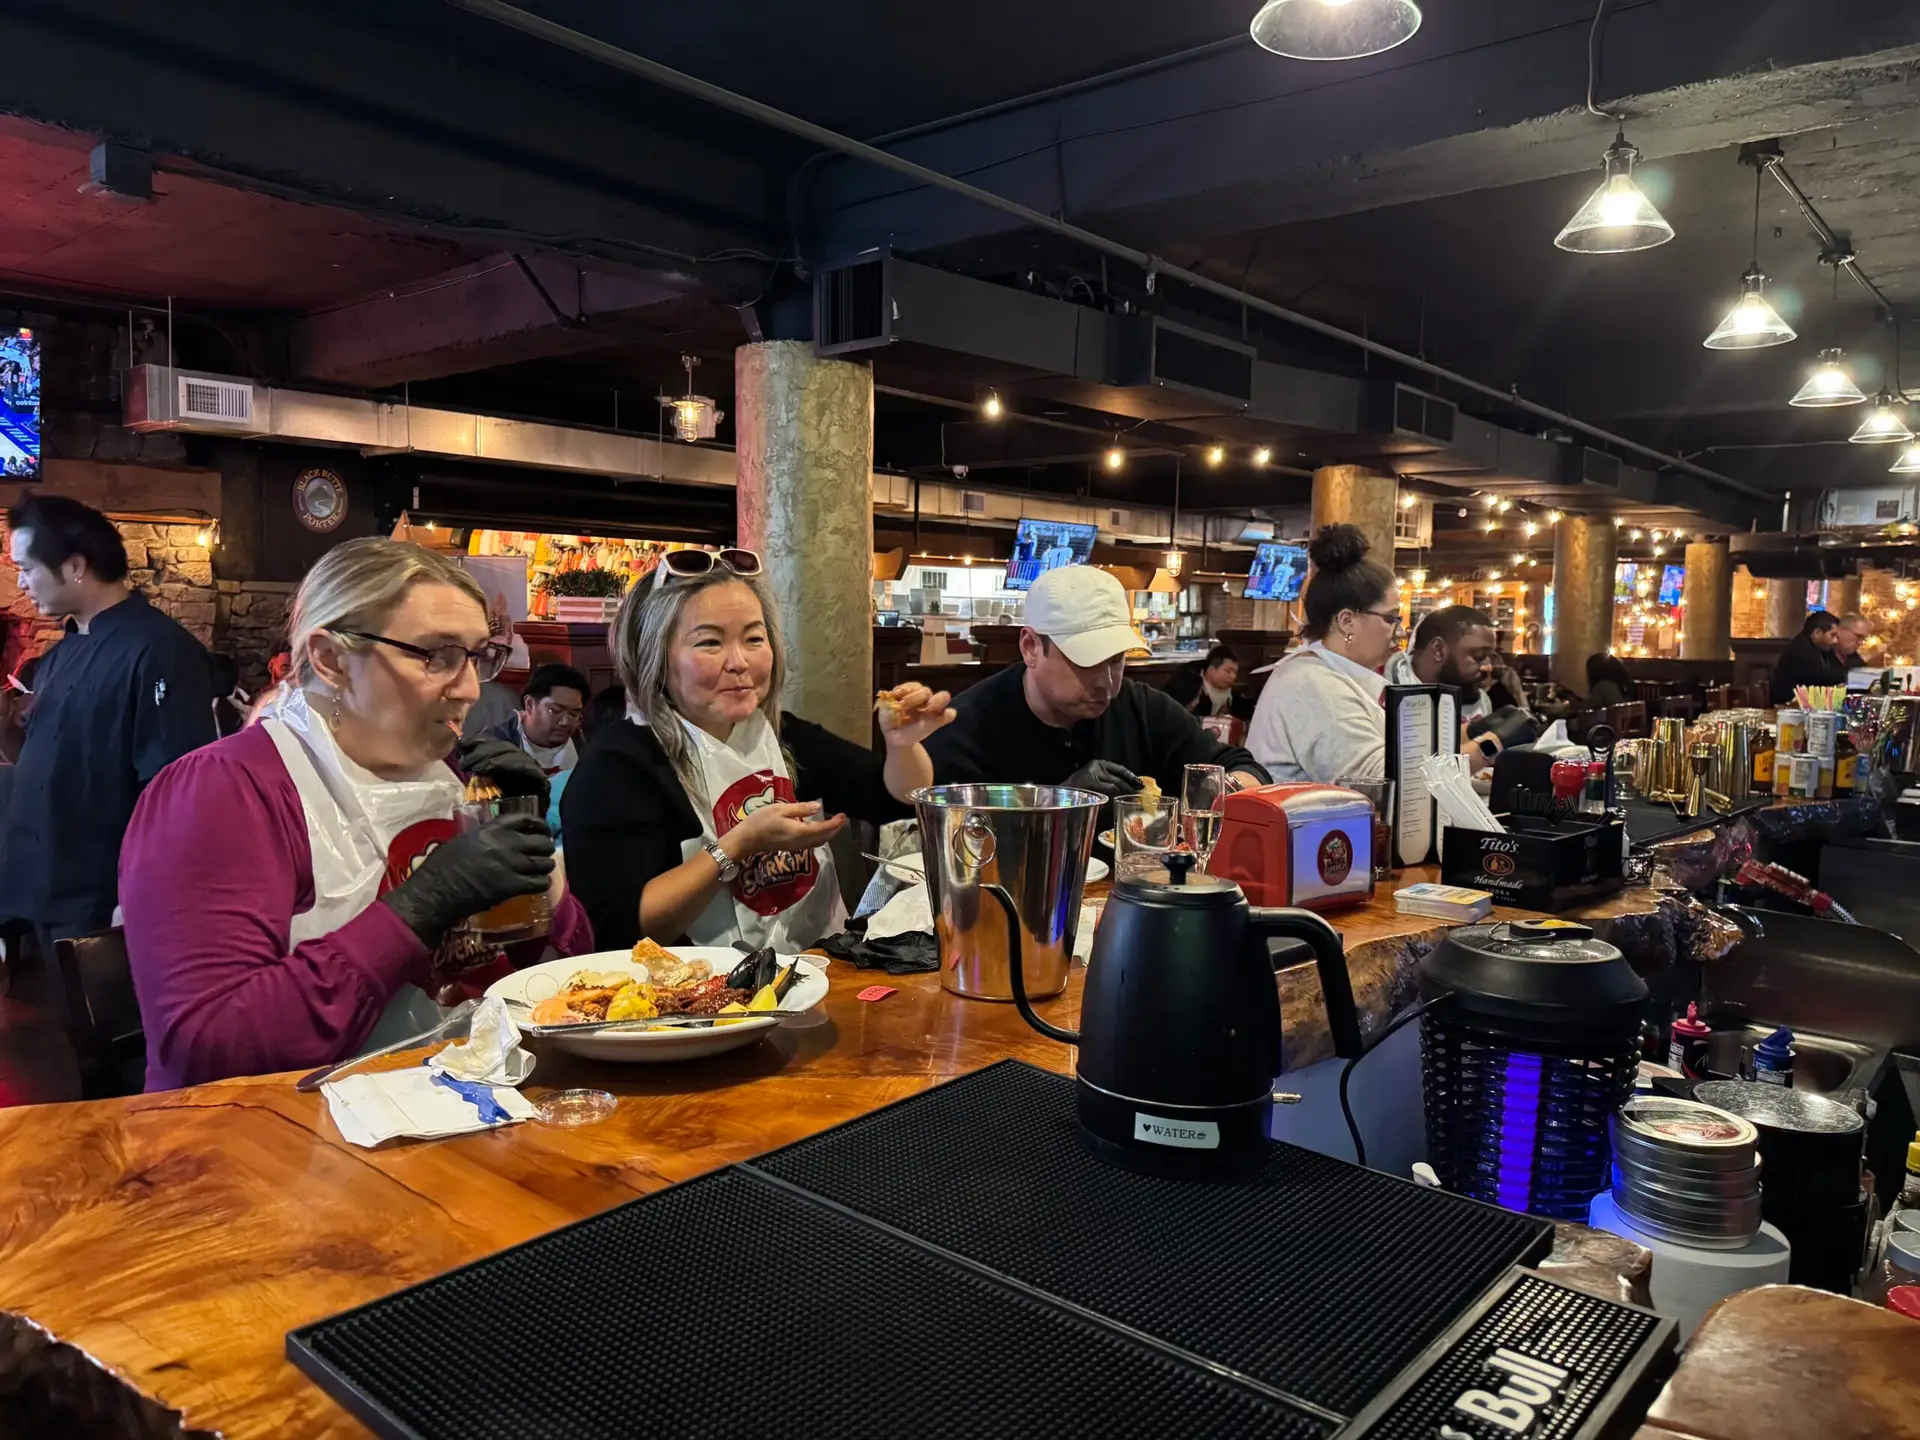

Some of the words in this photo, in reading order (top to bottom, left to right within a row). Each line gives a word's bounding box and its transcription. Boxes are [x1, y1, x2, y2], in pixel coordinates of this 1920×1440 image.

[297, 468, 321, 491] BLACK
[322, 469, 344, 494] BUTTE
[303, 512, 340, 528] PORTER
[1480, 837, 1519, 853] Tito's
[1473, 874, 1523, 890] Handmade
[1152, 1125, 1196, 1140] WATER
[1453, 1347, 1569, 1433] Bull
